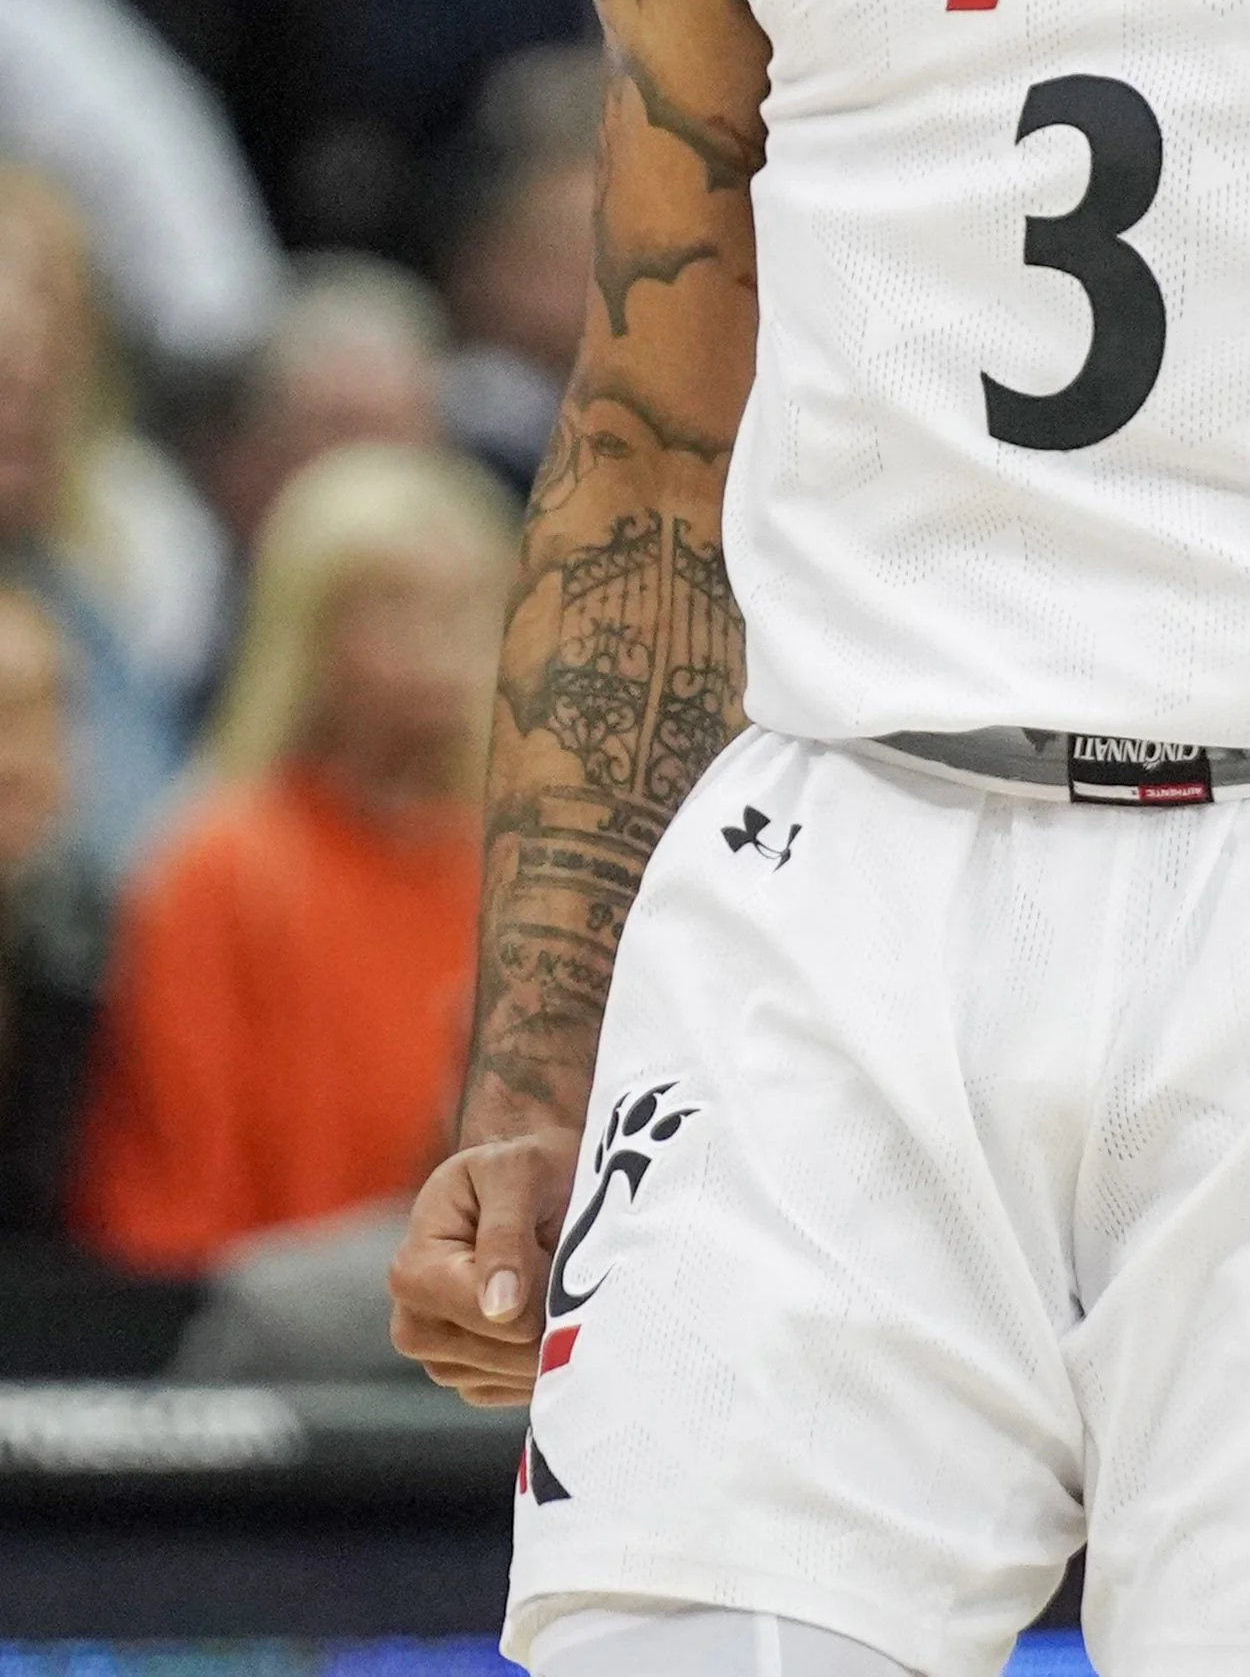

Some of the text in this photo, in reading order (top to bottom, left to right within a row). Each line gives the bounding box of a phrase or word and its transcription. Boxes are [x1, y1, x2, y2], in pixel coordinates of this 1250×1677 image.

[980, 73, 1166, 450] 3
[1073, 735, 1200, 763] CINCINNATI
[1145, 786, 1203, 798] AUTHENTIC
